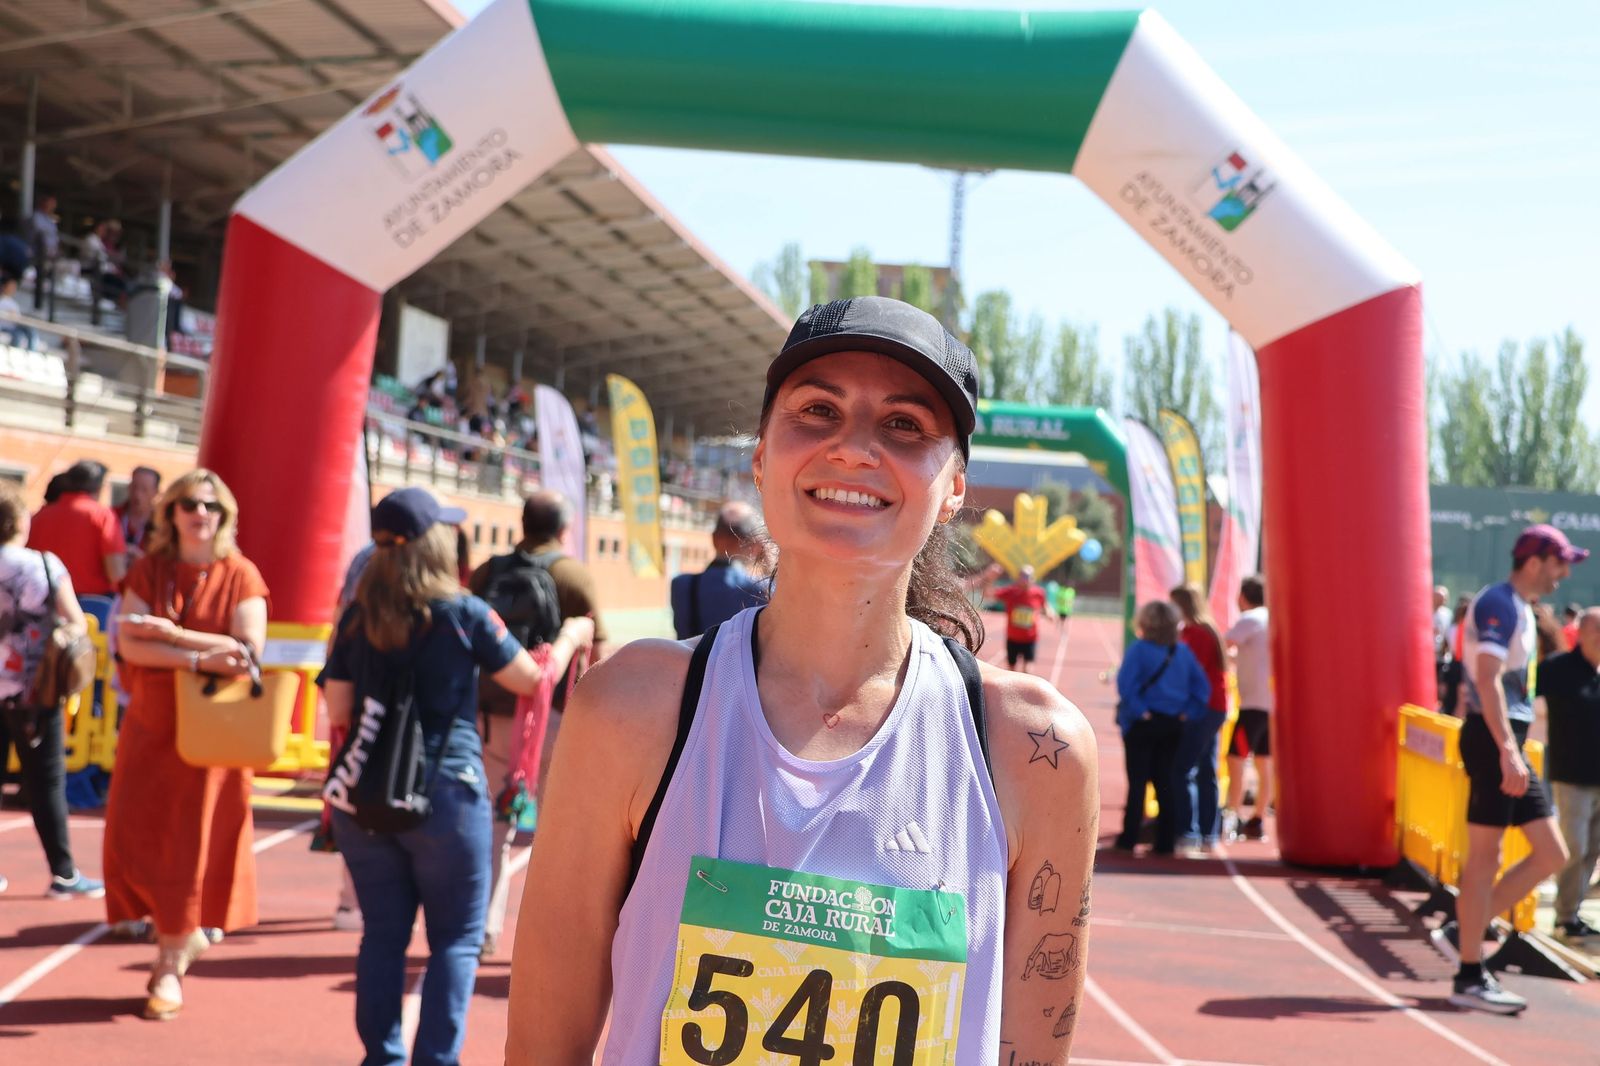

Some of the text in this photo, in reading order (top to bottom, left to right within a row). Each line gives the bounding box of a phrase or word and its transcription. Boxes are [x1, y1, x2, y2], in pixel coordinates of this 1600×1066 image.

[384, 127, 508, 231] AYUNTAMIENTO
[391, 148, 524, 249] DE ZAMORA
[1135, 170, 1254, 286] AYUNTAMIENTO
[1119, 181, 1237, 299] DE ZAMORA
[991, 414, 1071, 440] RURAL
[762, 920, 837, 942] DE ZAMORA
[765, 899, 897, 938] CAJA RURAL
[681, 952, 920, 1066] 540
